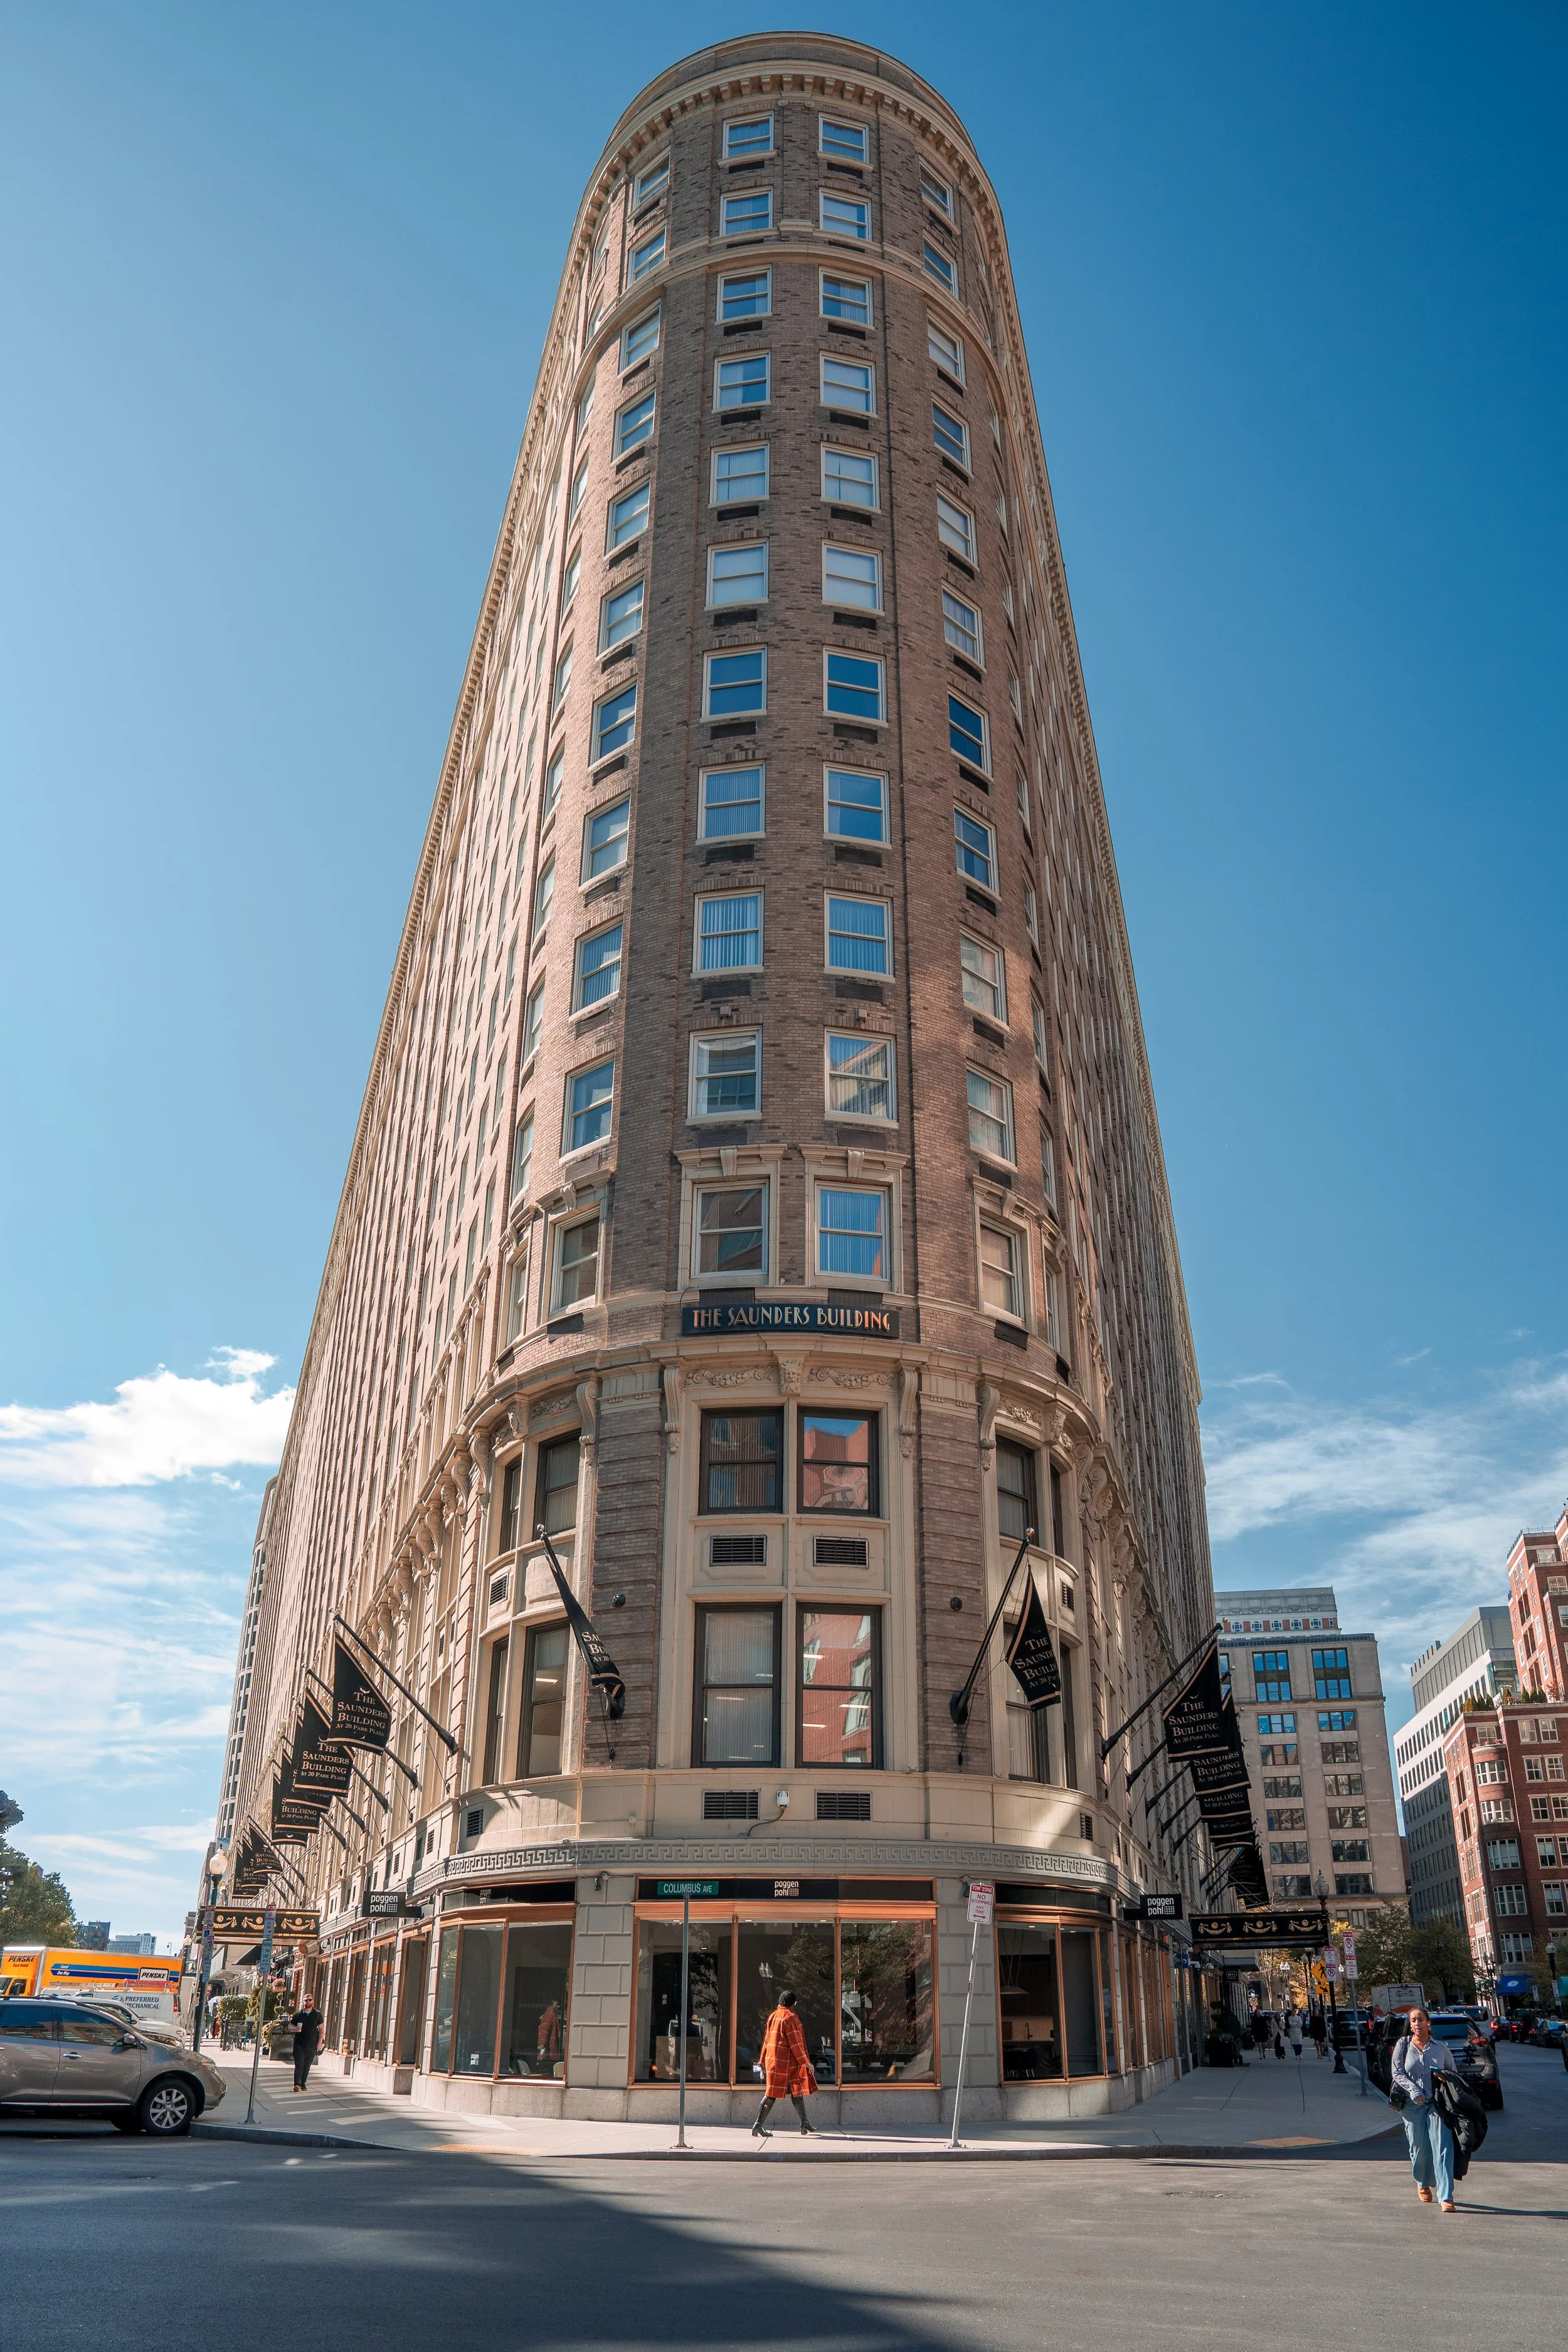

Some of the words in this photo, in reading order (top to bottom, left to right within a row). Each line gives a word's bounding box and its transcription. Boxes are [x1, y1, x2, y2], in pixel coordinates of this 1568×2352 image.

[693, 1310, 722, 1328] THE
[728, 1306, 810, 1326] SAUNDERS
[817, 1307, 891, 1332] BUILDING
[664, 1883, 701, 1893] COLUMBUS
[775, 1880, 798, 1888] poggen
[775, 1888, 788, 1897] pohl
[371, 1895, 398, 1904] poggen
[1147, 1898, 1174, 1907] poggen
[370, 1904, 386, 1913] pohl
[1148, 1906, 1163, 1916] pohl
